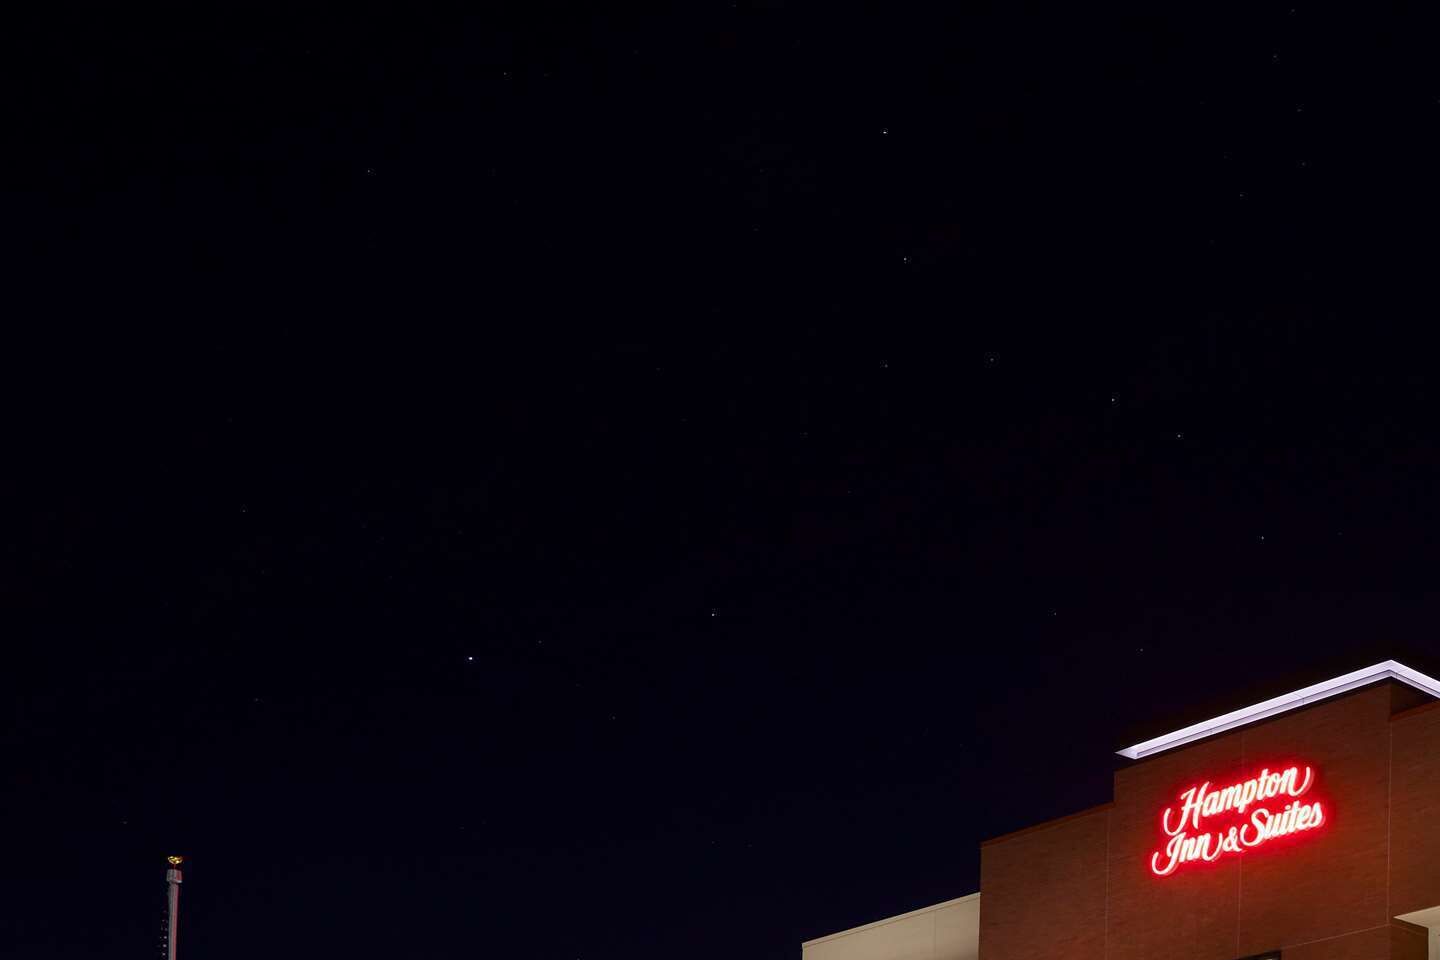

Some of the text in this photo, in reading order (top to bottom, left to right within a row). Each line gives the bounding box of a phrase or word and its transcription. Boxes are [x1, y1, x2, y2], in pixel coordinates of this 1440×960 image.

[1151, 800, 1325, 876] Inn & Suites
[1163, 766, 1313, 837] Hampton
